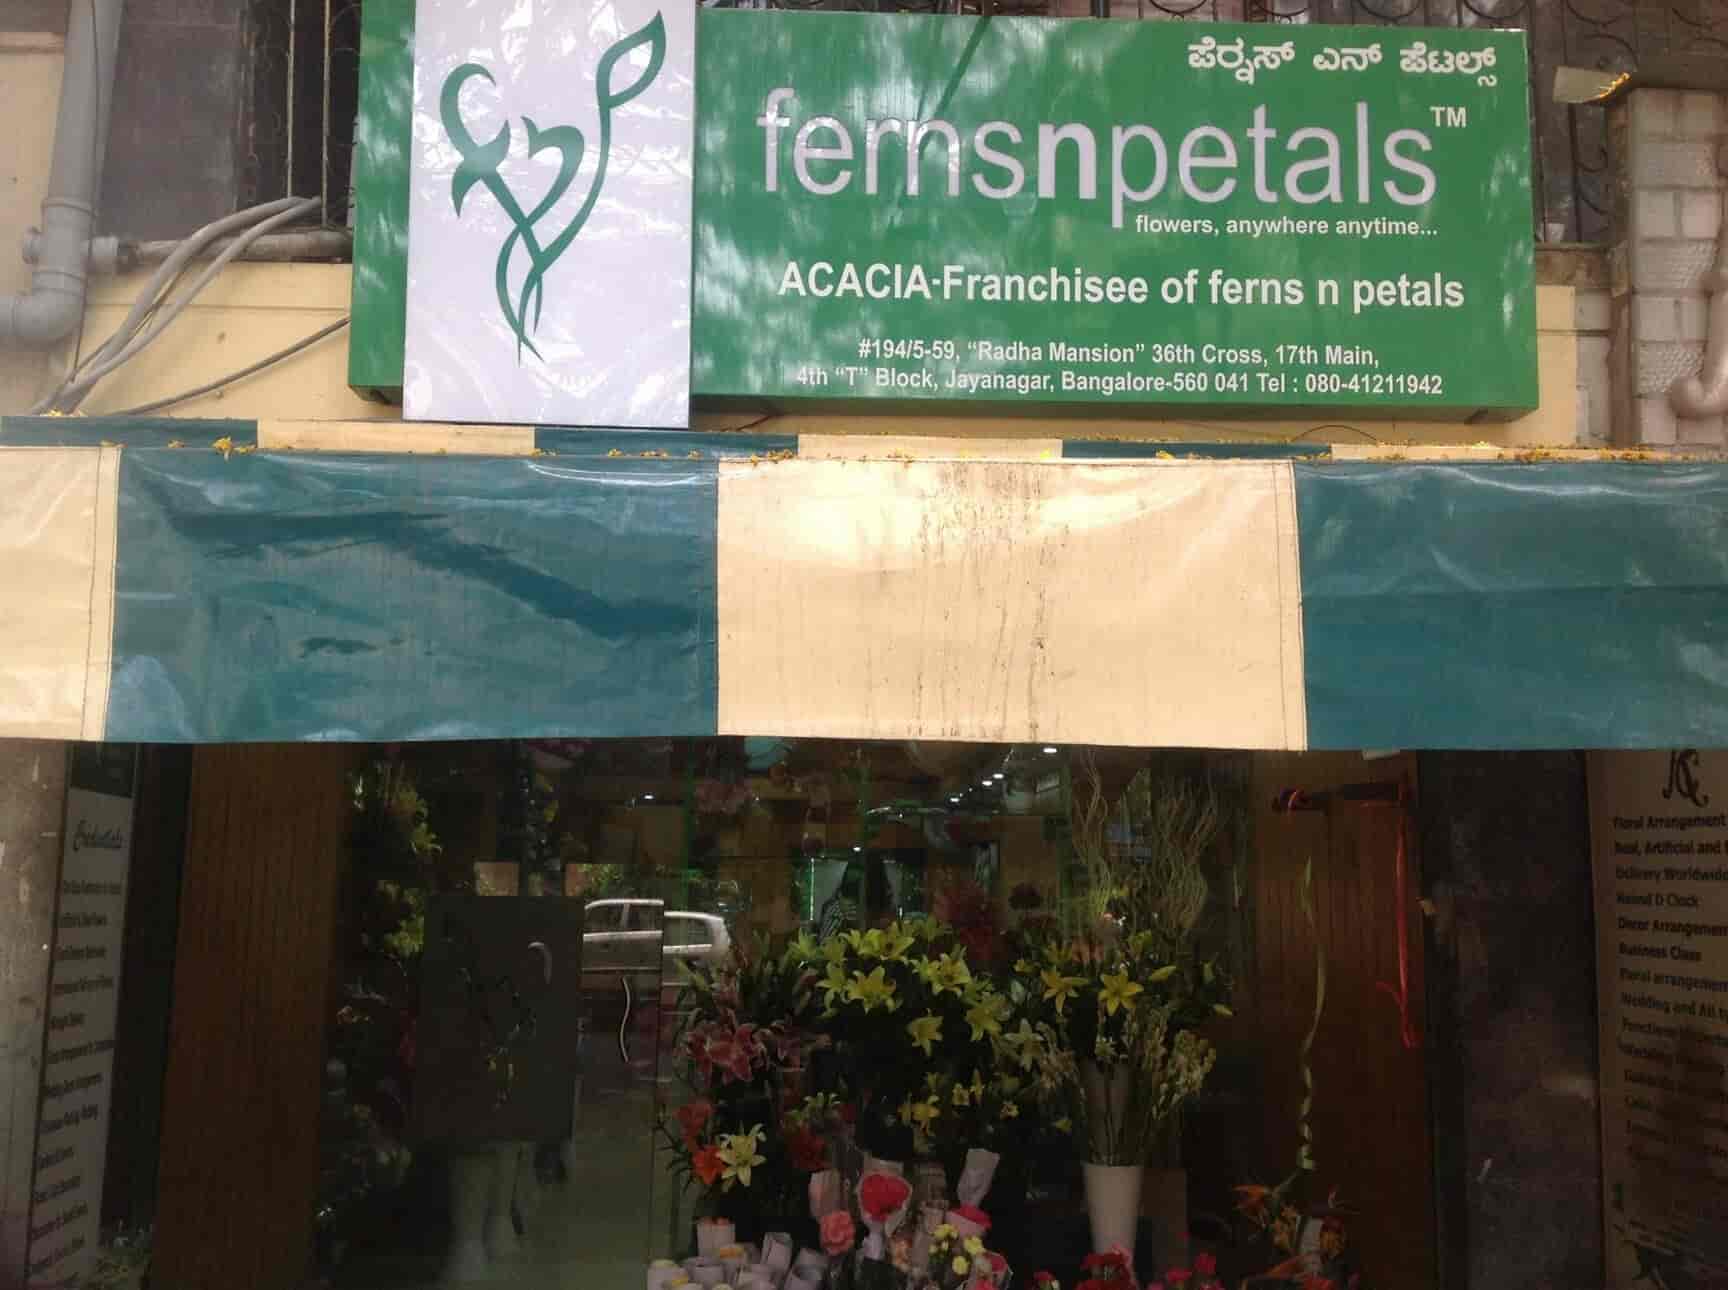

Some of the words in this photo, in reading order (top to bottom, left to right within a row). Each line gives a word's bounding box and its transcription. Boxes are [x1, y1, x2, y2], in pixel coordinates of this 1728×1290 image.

[1430, 106, 1467, 128] TM
[1136, 214, 1219, 235] flowers,
[1226, 217, 1329, 238] anywhere
[1335, 218, 1438, 238] anytime...
[777, 261, 1148, 303] ACACIA-Franchisee
[1161, 269, 1199, 303] of
[1208, 269, 1304, 305] ferns
[1318, 278, 1339, 305] n
[1353, 272, 1465, 314] petals
[858, 338, 960, 361] #194/5-59,
[1152, 344, 1195, 364] 36th
[1202, 344, 1268, 367] Cross,
[1276, 345, 1318, 366] 17th
[1325, 346, 1379, 368] Main,
[796, 366, 828, 387] 4th
[875, 367, 938, 390] Block,
[946, 368, 1054, 395] Jayanagar,
[1061, 371, 1207, 396] Bangalore-560
[1214, 373, 1248, 392] 041
[1256, 373, 1286, 392] Tel
[1305, 374, 1443, 394] 080-41211942
